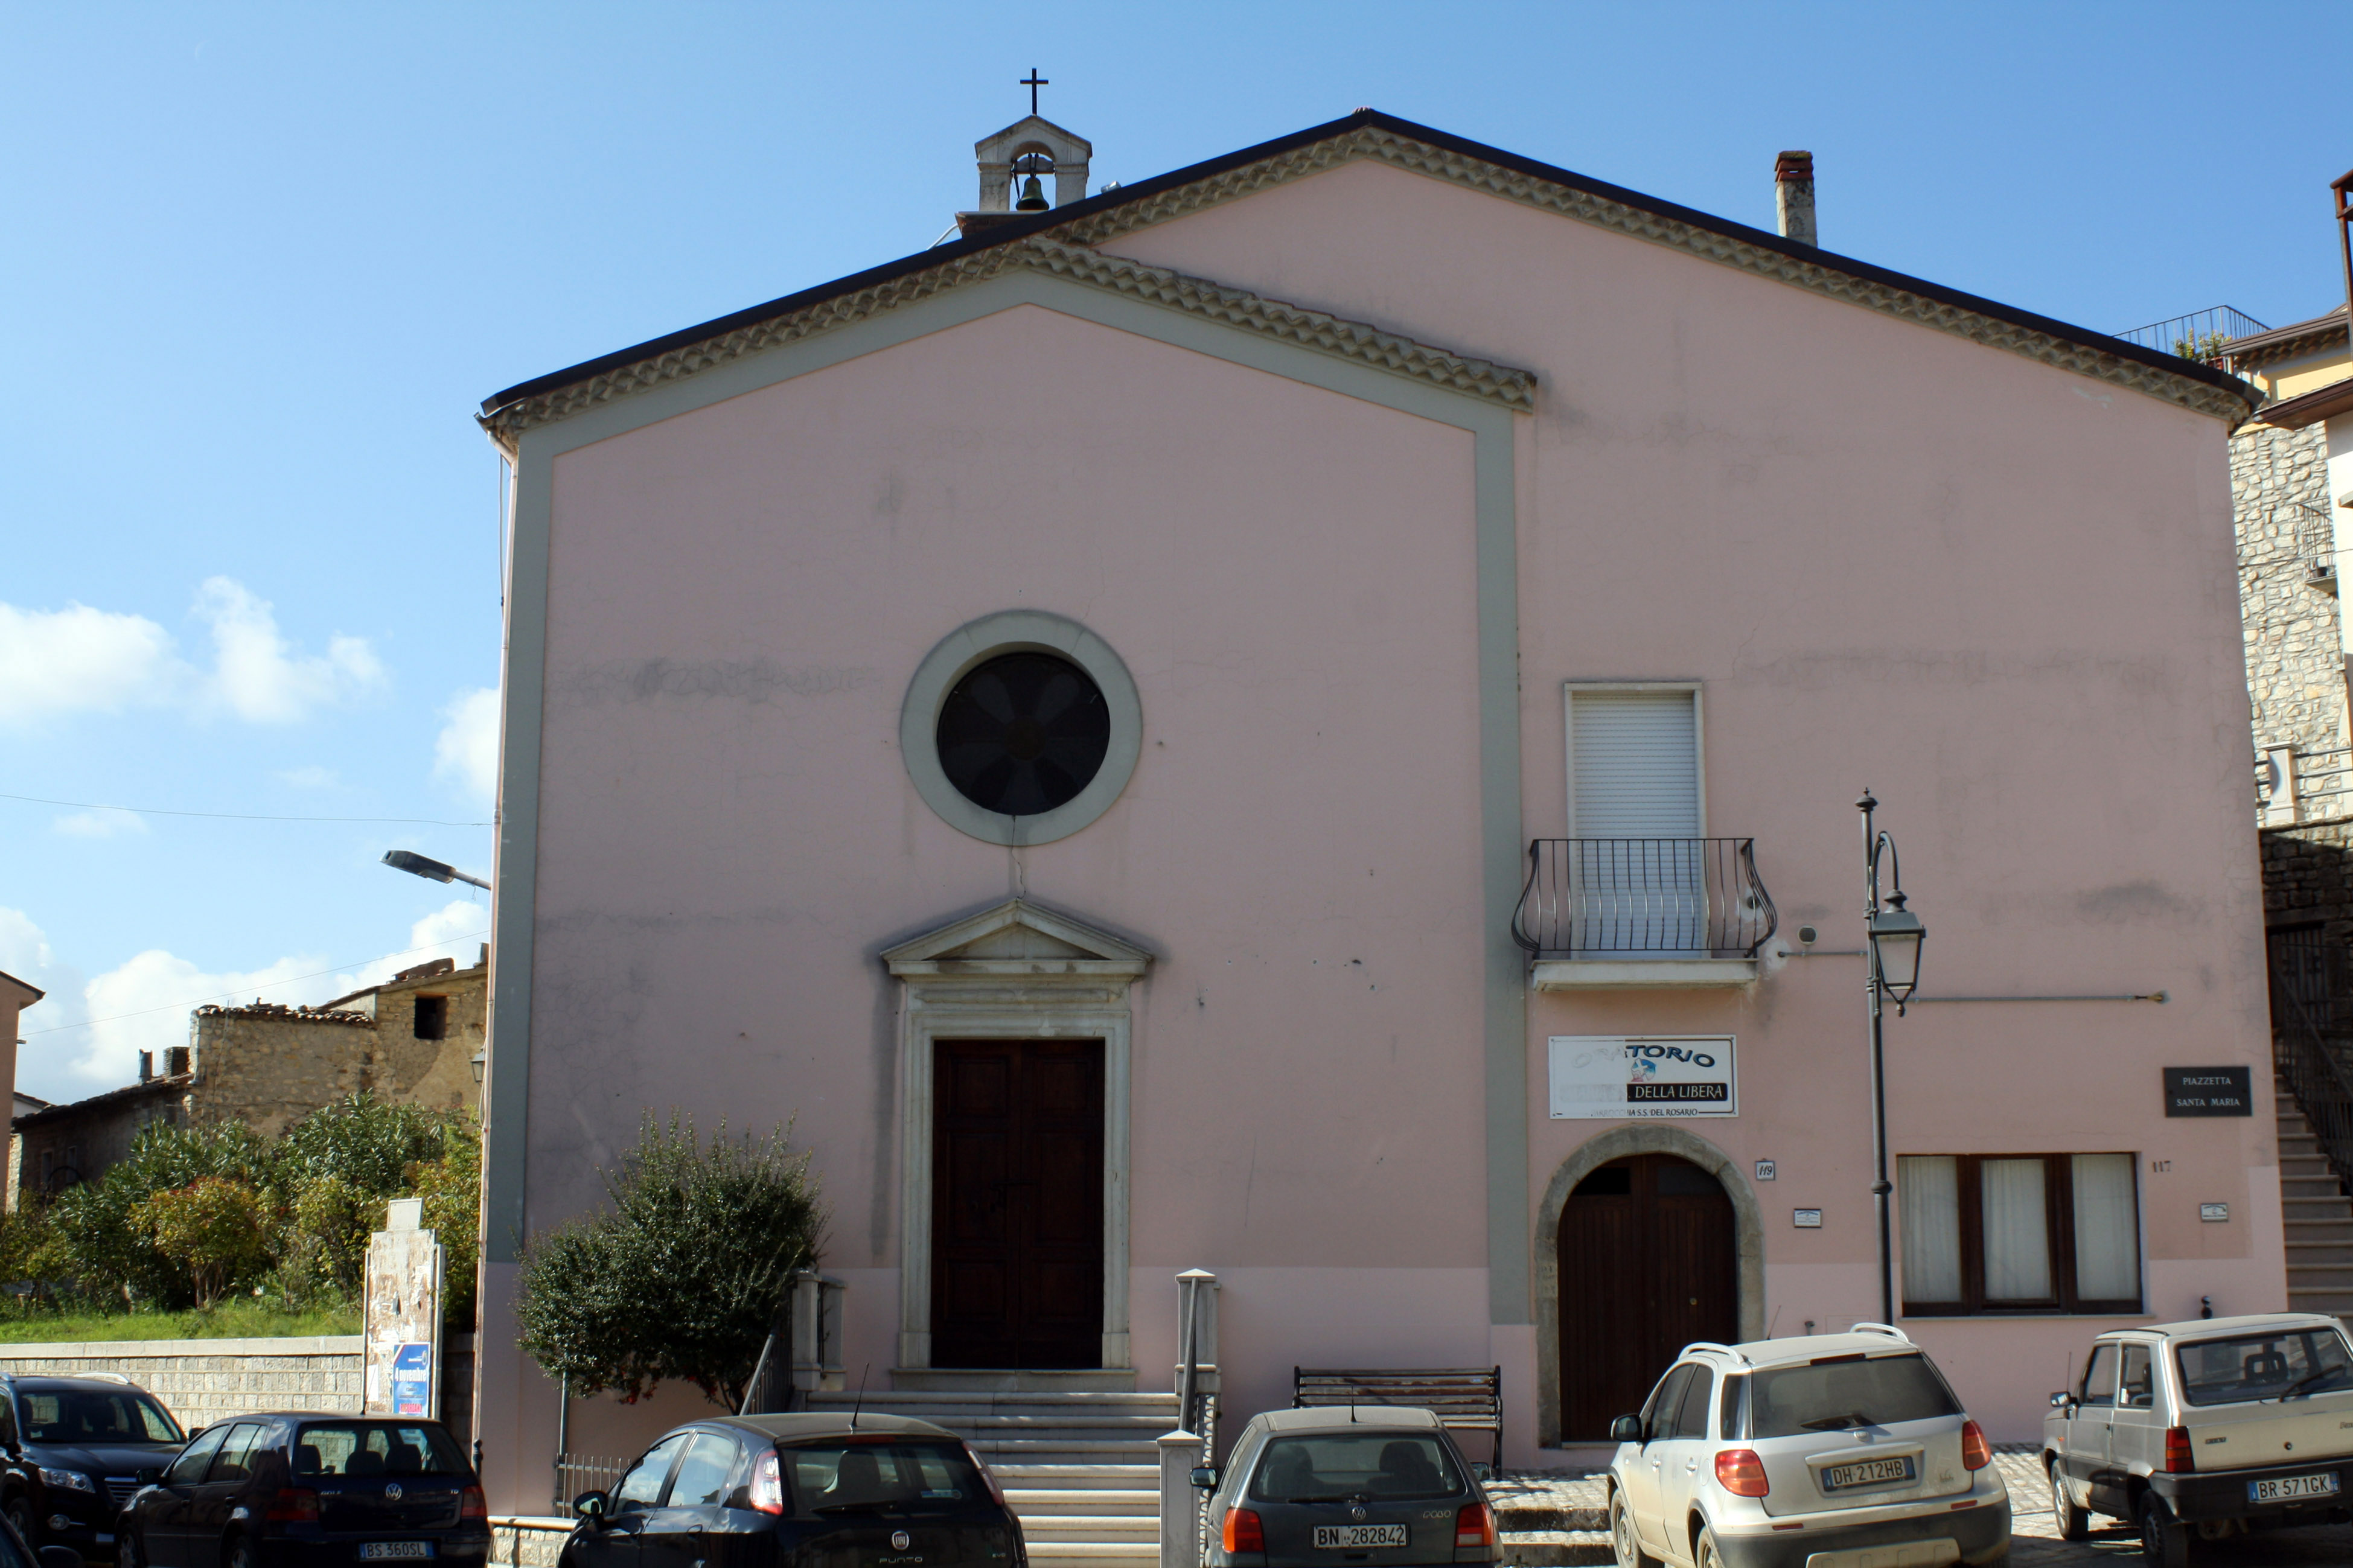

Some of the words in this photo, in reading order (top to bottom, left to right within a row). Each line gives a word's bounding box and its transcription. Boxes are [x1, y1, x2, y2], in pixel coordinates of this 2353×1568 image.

[2182, 1077, 2232, 1085] PIAZZETTA
[1635, 1086, 1675, 1098] DELLA
[1679, 1085, 1723, 1099] LIBERA
[2176, 1098, 2206, 1106] SANTA
[2211, 1098, 2240, 1106] MARIA
[1666, 1108, 1698, 1117] ROSARIO
[1759, 1165, 1773, 1176] 119
[2152, 1160, 2171, 1173] 117
[395, 1367, 399, 1382] 4
[399, 1367, 427, 1382] novembre
[1833, 1467, 1853, 1485] DH
[1857, 1461, 1903, 1481] 212HB
[2258, 1481, 2278, 1499] BR
[2283, 1476, 2329, 1495] 571GK
[1318, 1528, 1339, 1545] BN
[1351, 1527, 1405, 1544] 282842
[366, 1544, 382, 1557] BS
[386, 1542, 424, 1556] 360SL
